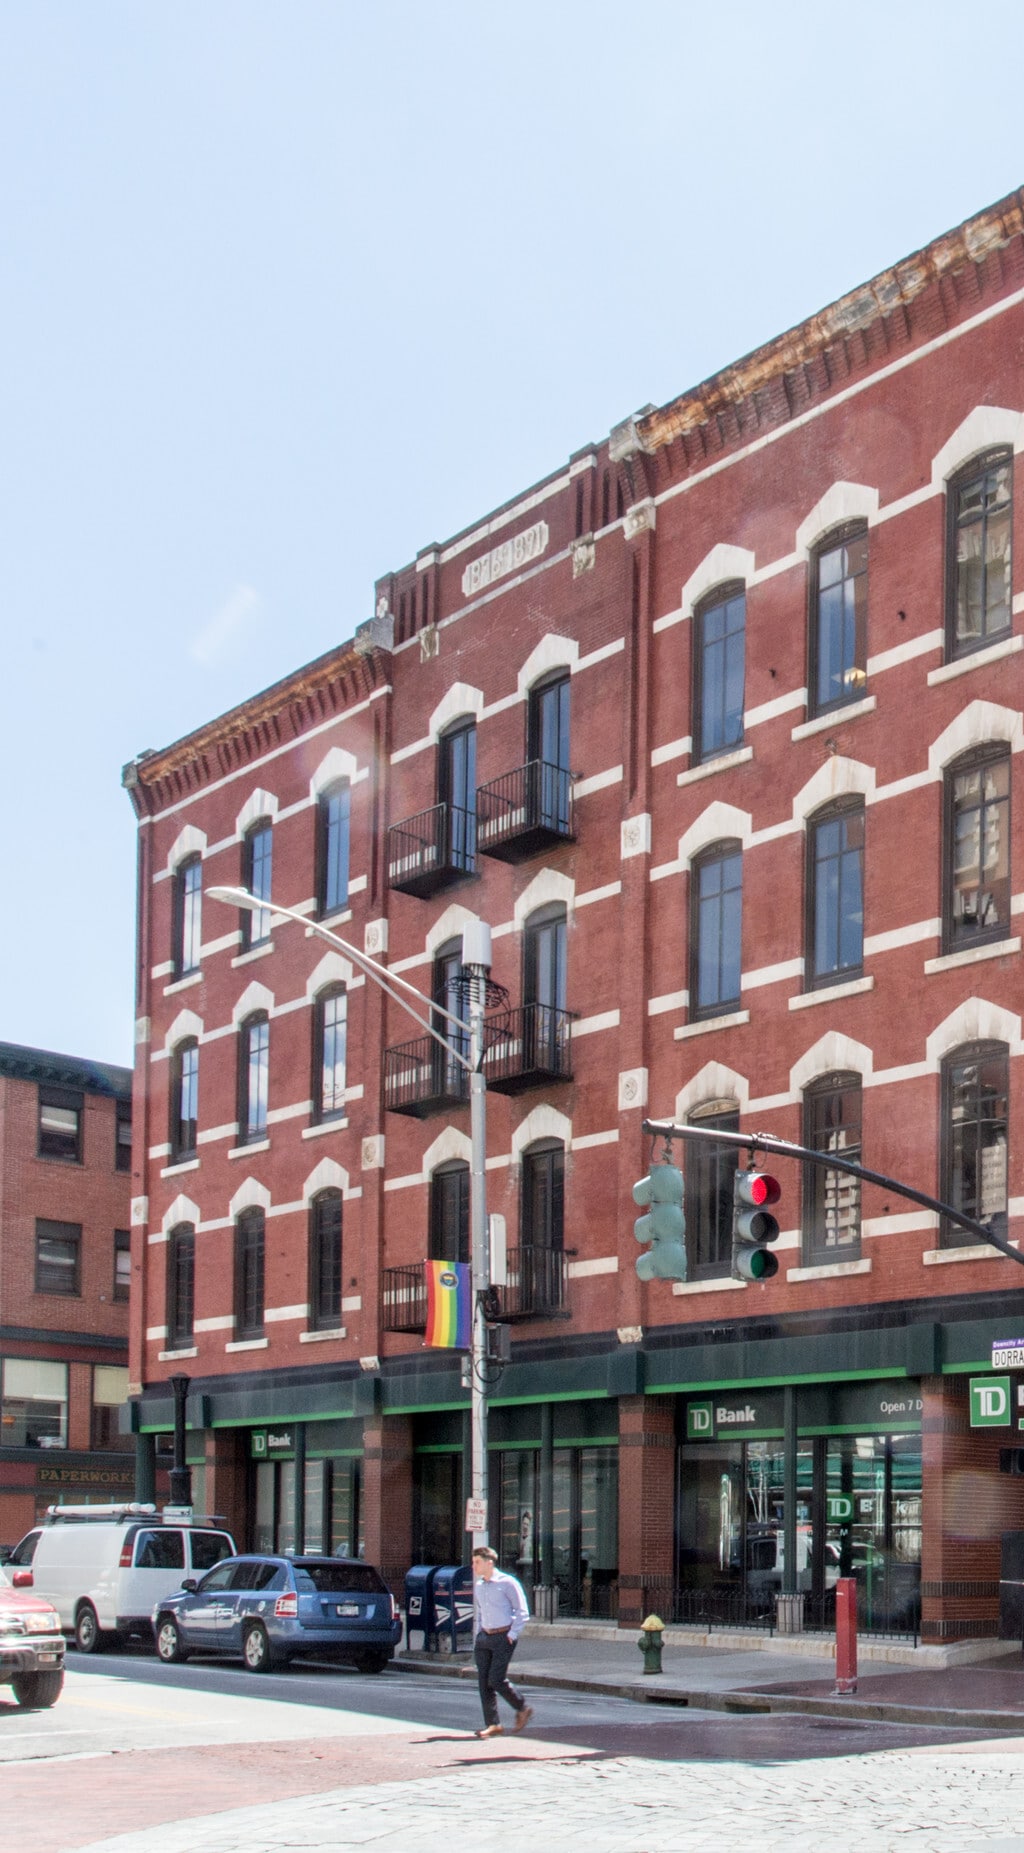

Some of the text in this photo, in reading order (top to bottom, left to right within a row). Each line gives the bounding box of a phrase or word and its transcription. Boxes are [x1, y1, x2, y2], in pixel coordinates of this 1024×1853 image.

[993, 1341, 1016, 1349] Downcity
[880, 1401, 906, 1415] Open
[908, 1399, 914, 1411] 7
[973, 1386, 1007, 1417] TD
[689, 1405, 756, 1430] TD Bank
[268, 1433, 291, 1447] Bank
[827, 1498, 852, 1517] TD
